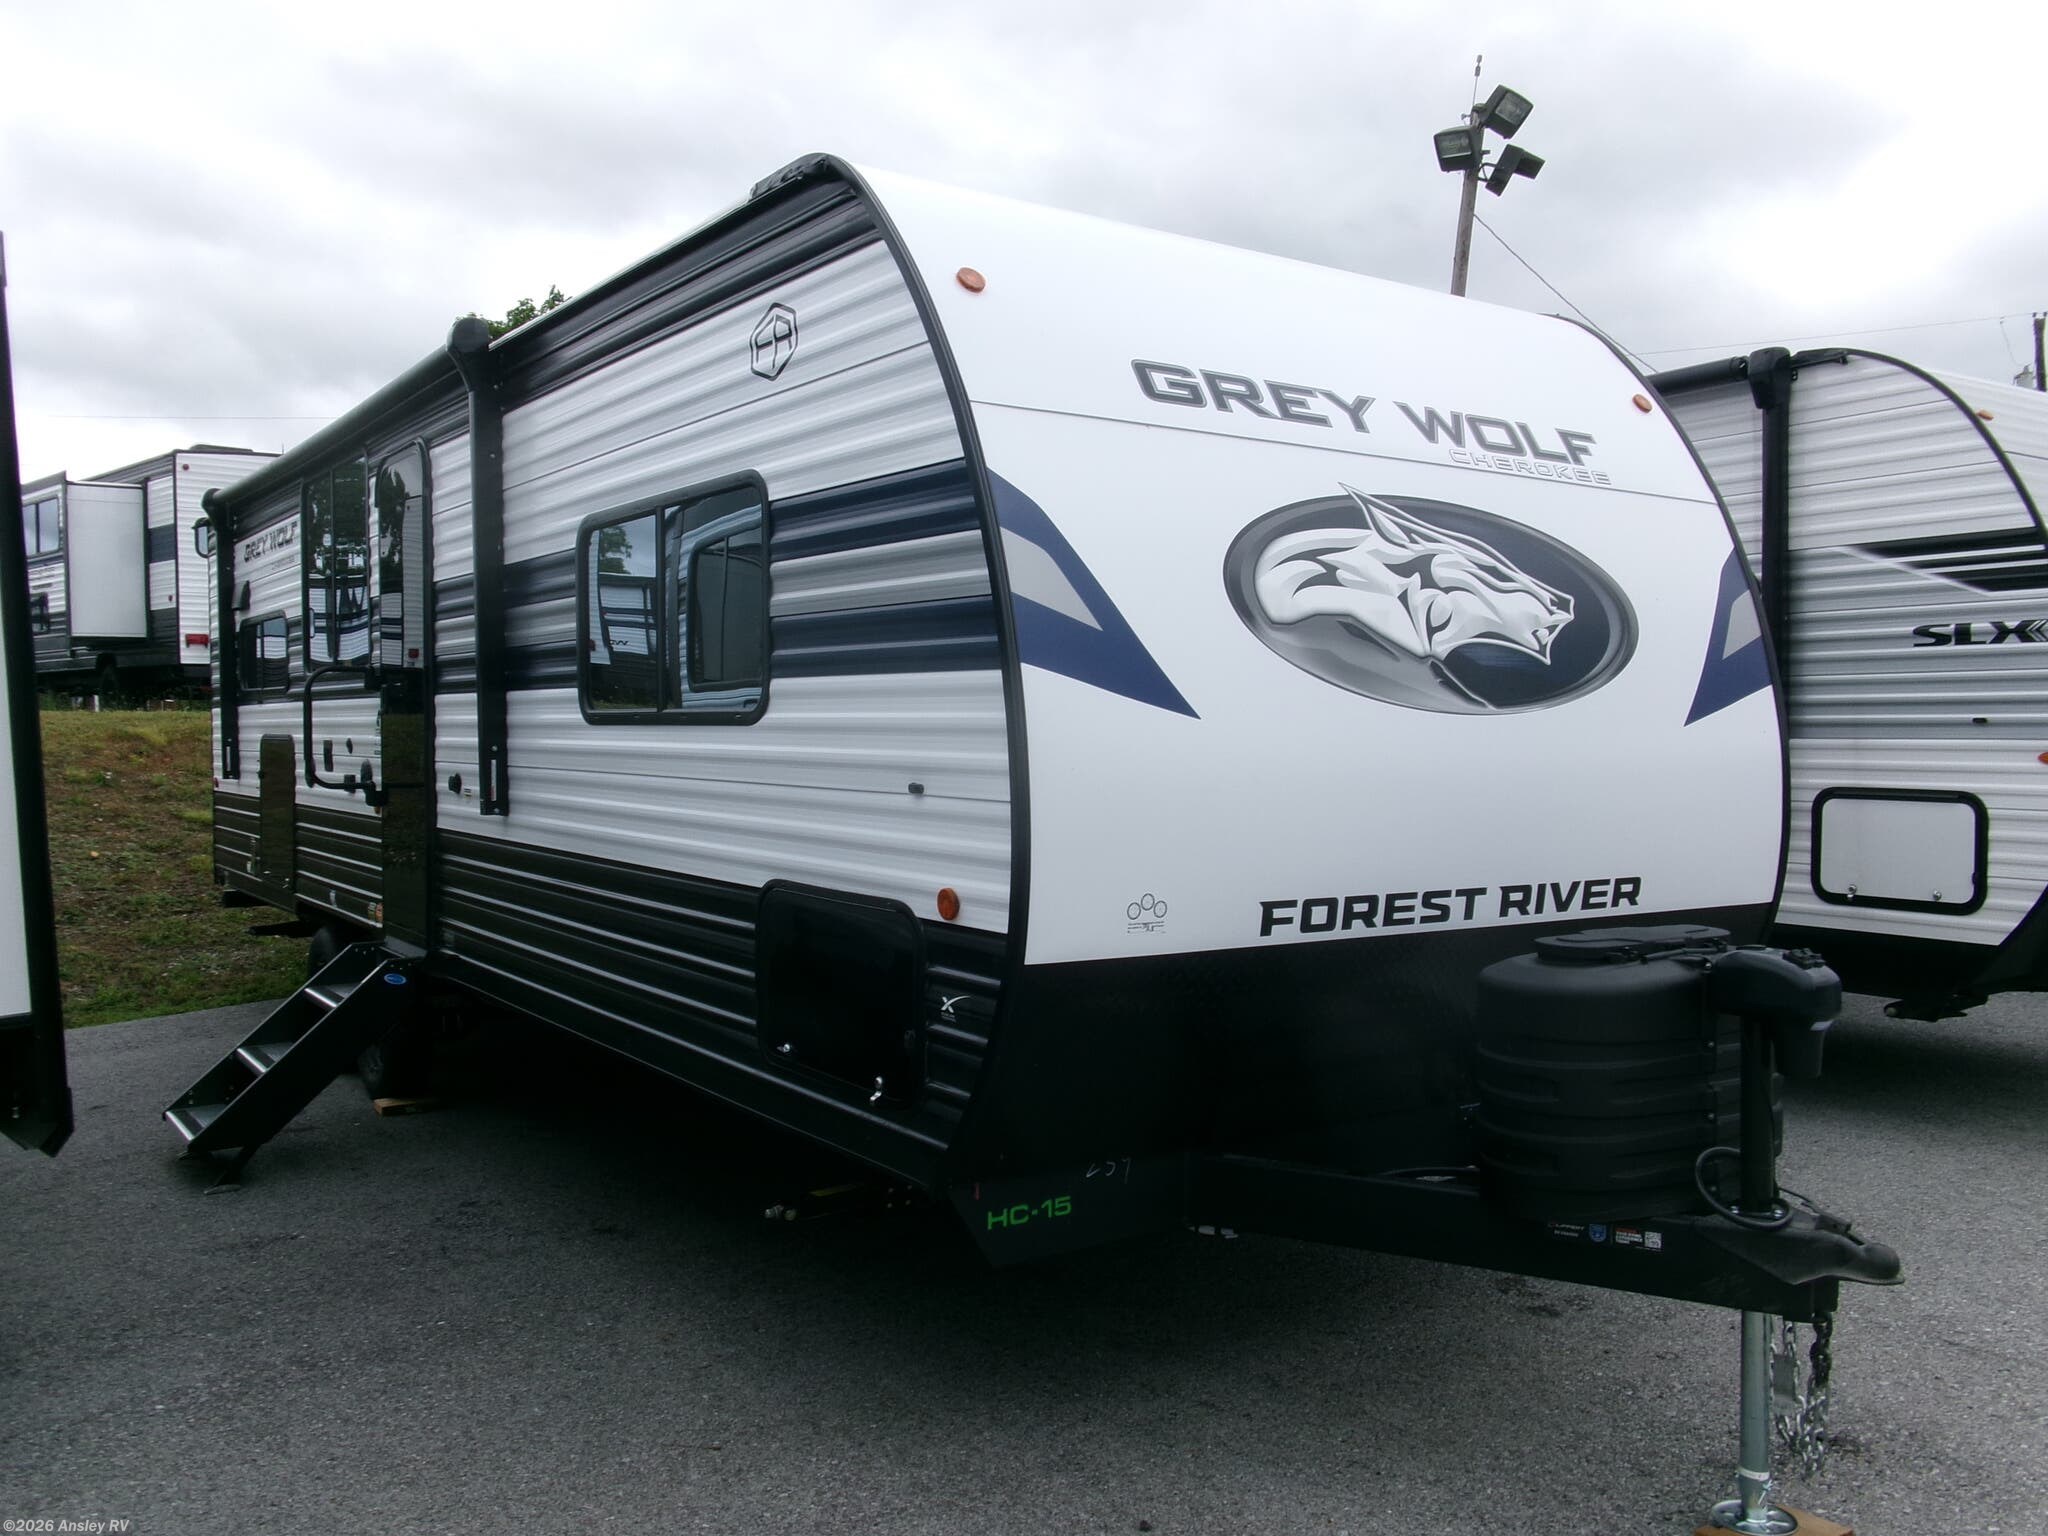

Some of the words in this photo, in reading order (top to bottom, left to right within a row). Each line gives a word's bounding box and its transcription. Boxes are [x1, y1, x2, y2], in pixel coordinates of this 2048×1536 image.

[1131, 359, 1376, 434] GREY
[1392, 400, 1597, 467] WOLF
[1449, 448, 1612, 486] CHEROKEE
[243, 533, 268, 563] GREY
[1259, 887, 1488, 938] FOREST
[1499, 876, 1642, 918] RIVER
[986, 1196, 1072, 1230] HC-15
